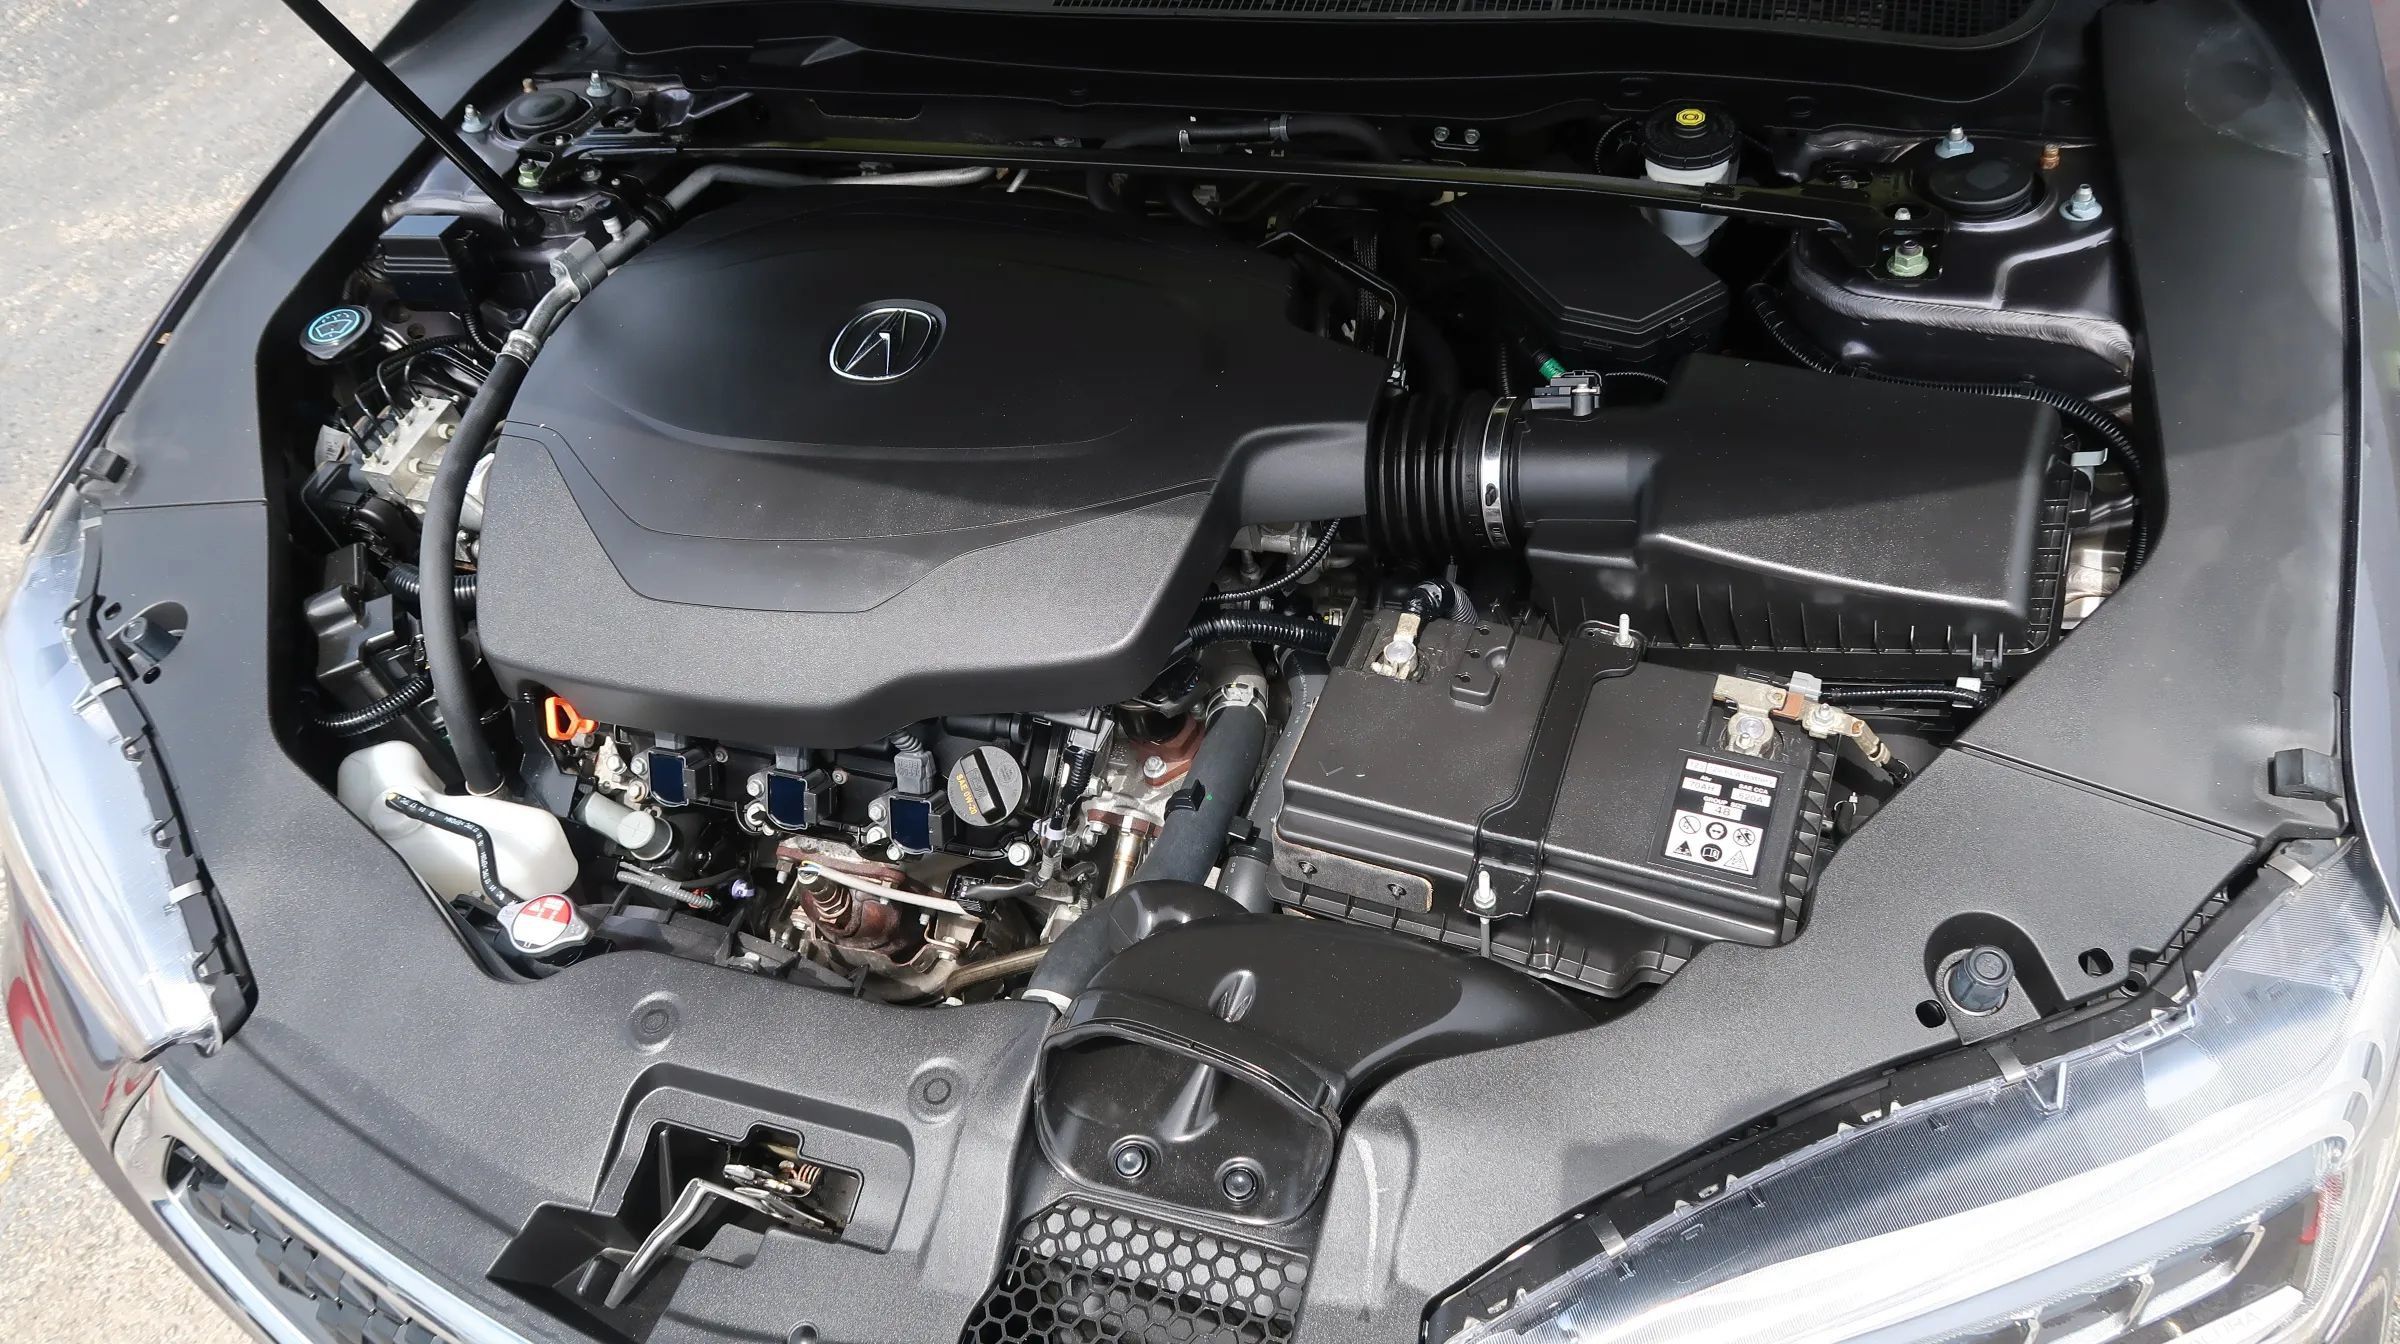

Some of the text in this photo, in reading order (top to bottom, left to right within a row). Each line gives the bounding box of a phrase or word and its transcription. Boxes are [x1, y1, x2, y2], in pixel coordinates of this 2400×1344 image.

[956, 773, 969, 792] SAE
[963, 791, 978, 815] 0W-20
[1715, 806, 1731, 816] 48
